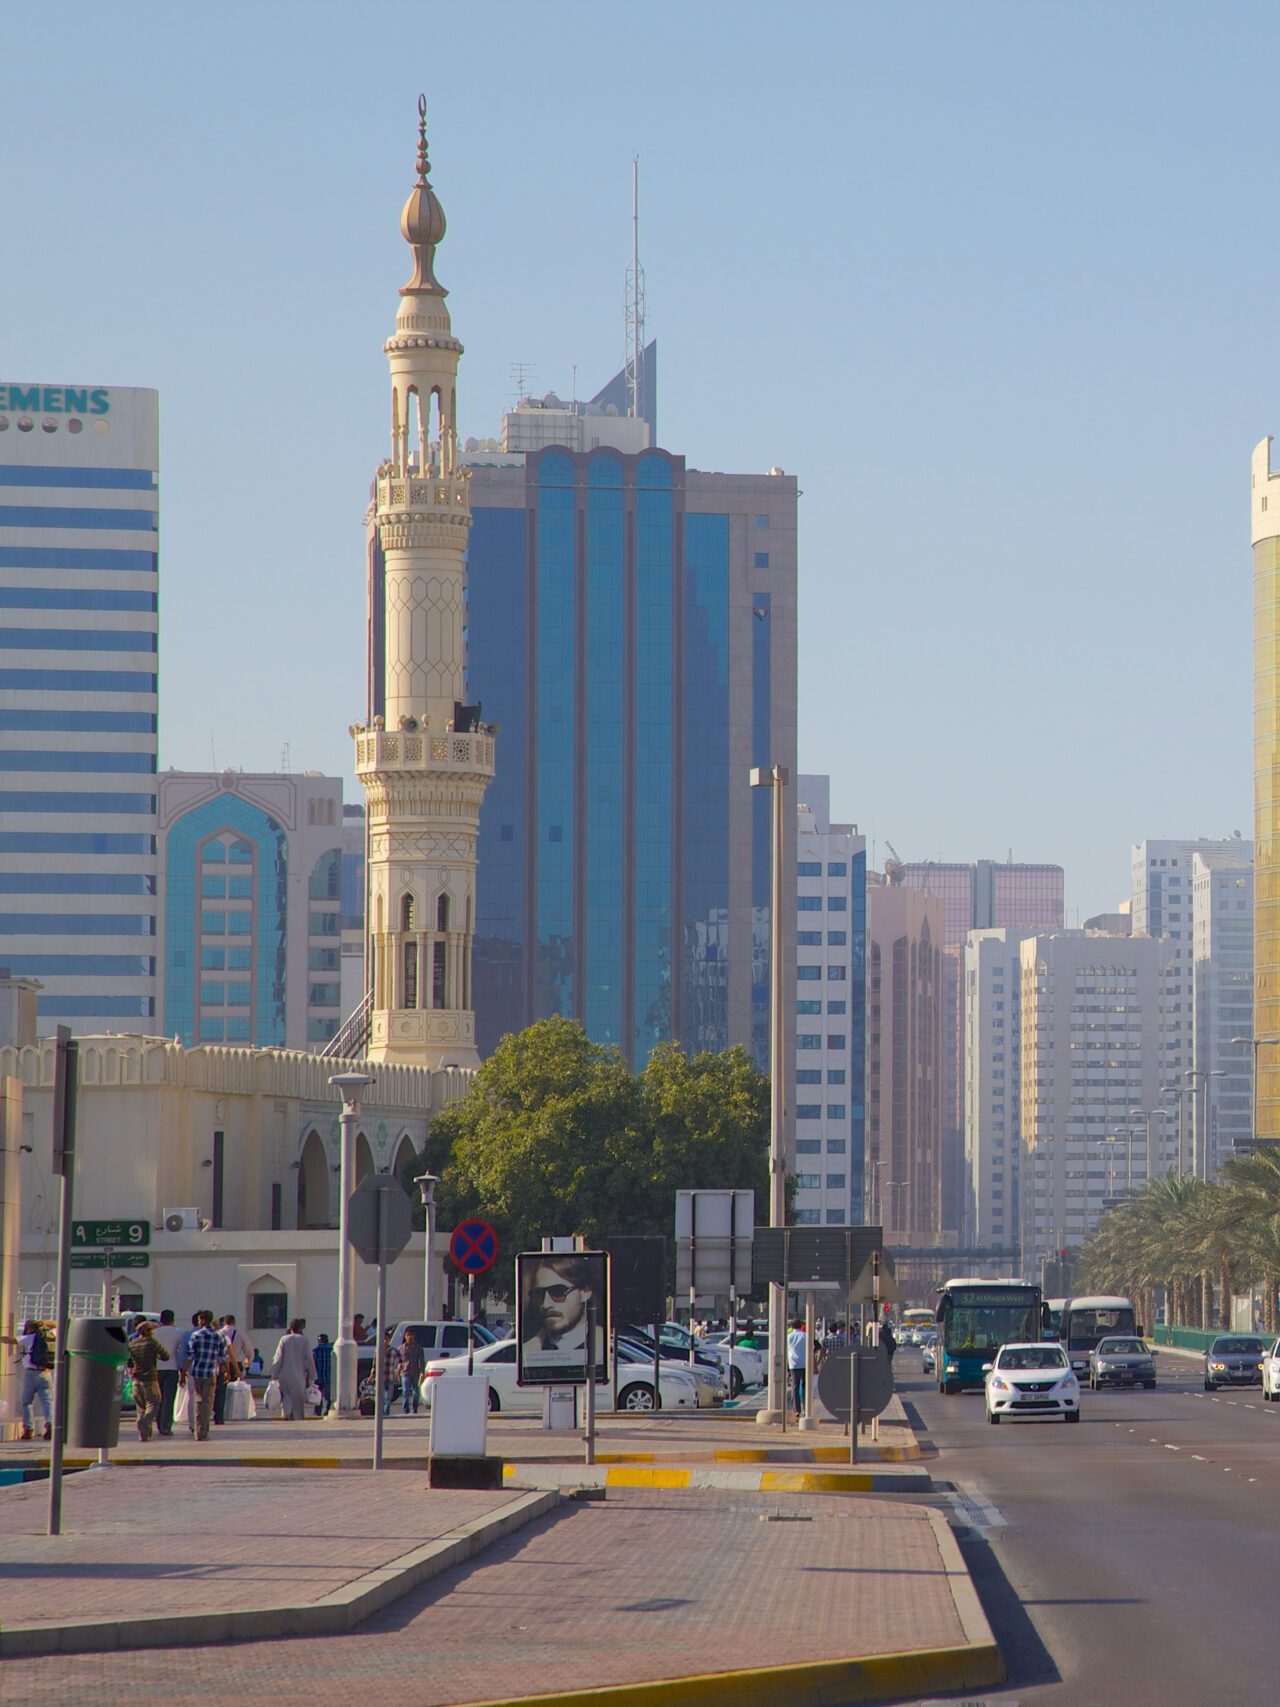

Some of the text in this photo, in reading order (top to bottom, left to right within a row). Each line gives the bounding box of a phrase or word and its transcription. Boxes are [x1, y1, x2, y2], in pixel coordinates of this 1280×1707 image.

[95, 1224, 122, 1237] شارع
[128, 1224, 143, 1243] 9
[961, 1292, 976, 1303] 32
